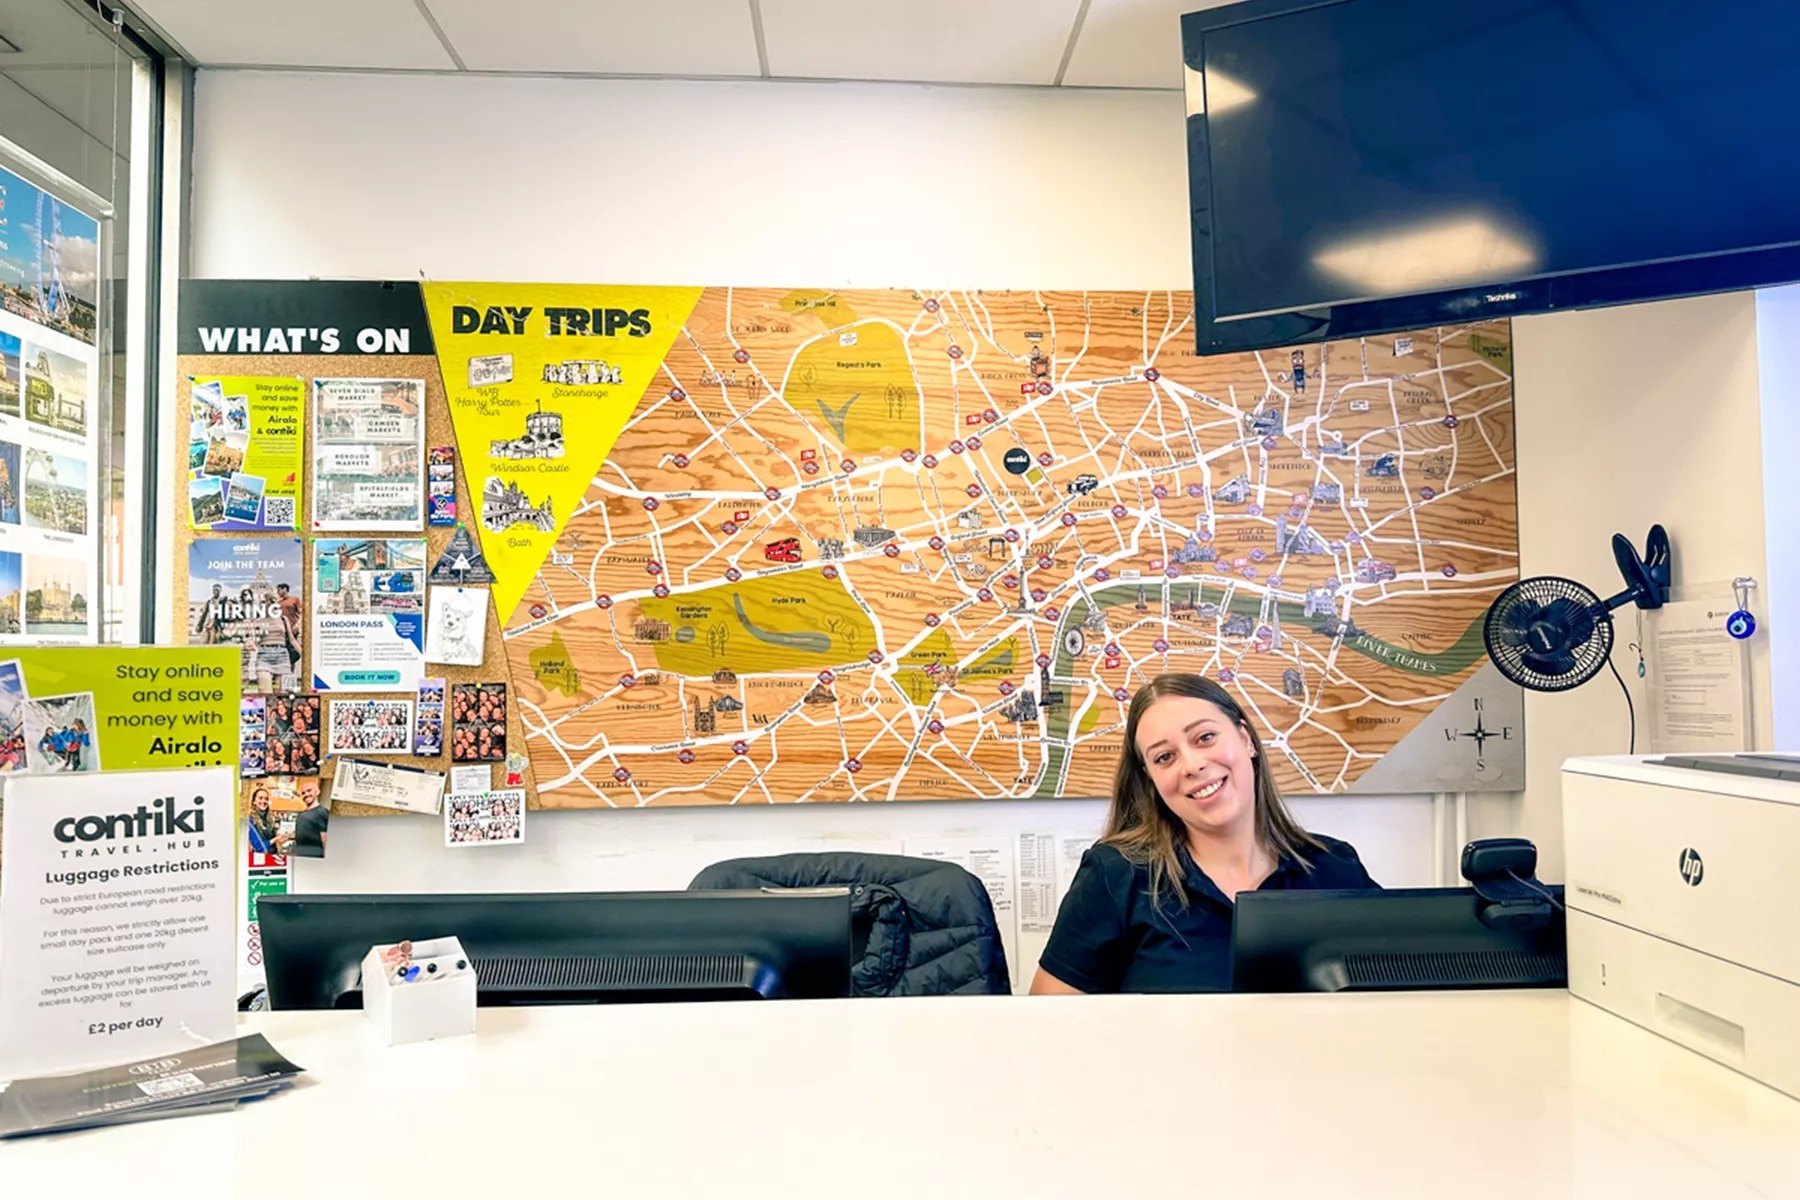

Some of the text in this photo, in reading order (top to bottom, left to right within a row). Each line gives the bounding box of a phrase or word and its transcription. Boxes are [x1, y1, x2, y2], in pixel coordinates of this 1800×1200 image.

[452, 306, 652, 337] DAY TRIPS
[197, 327, 410, 353] WHAT'S ON
[256, 383, 298, 393] Stay online
[552, 388, 609, 399] Stonehenge
[261, 394, 278, 402] and
[455, 397, 521, 410] Harry Potter
[252, 404, 298, 414] money with
[268, 415, 297, 424] Airalo
[266, 426, 297, 435] contiki
[491, 464, 570, 473] Windsor Castle
[232, 542, 260, 552] contiki
[507, 538, 532, 548] Bath
[207, 560, 285, 570] JOIN THE TEAM
[209, 603, 282, 619] HIRING
[116, 664, 224, 682] Stay online
[132, 688, 224, 703] and save
[1474, 698, 1484, 711] N
[107, 710, 223, 729] money with
[1444, 727, 1512, 742] W E
[149, 735, 222, 755] Airalo
[1476, 759, 1485, 771] S
[53, 795, 204, 843] contiki
[45, 859, 219, 885] Luggage Restrictions
[1680, 847, 1703, 887] hp
[40, 897, 59, 905] Due
[73, 893, 96, 902] strict
[98, 889, 142, 901] European
[144, 887, 165, 896] road
[167, 882, 216, 893] restrictions
[53, 905, 93, 916] luggage
[95, 902, 128, 911] cannot
[130, 898, 158, 908] weigh
[159, 897, 179, 905] over
[43, 930, 58, 938] For
[60, 928, 77, 936] this
[132, 918, 161, 929] strictly
[163, 916, 187, 926] allow
[188, 914, 206, 922] one
[40, 941, 67, 950] small
[68, 938, 86, 948] day
[89, 935, 112, 946] pack
[114, 933, 133, 942] and
[154, 928, 176, 938] 20kg
[178, 925, 209, 934] decent
[86, 941, 166, 956] size suitcase only
[50, 974, 73, 983] Your
[75, 969, 115, 981] luggage
[116, 966, 132, 975] will
[147, 960, 186, 972] weighed
[188, 958, 200, 966] on
[41, 983, 89, 997] departure
[92, 981, 103, 990] by
[105, 979, 126, 989] your
[128, 976, 144, 986] trip
[191, 968, 208, 978] Any
[38, 979, 212, 1008] excess luggage can be stored with us
[88, 1016, 163, 1035] £2 per day
